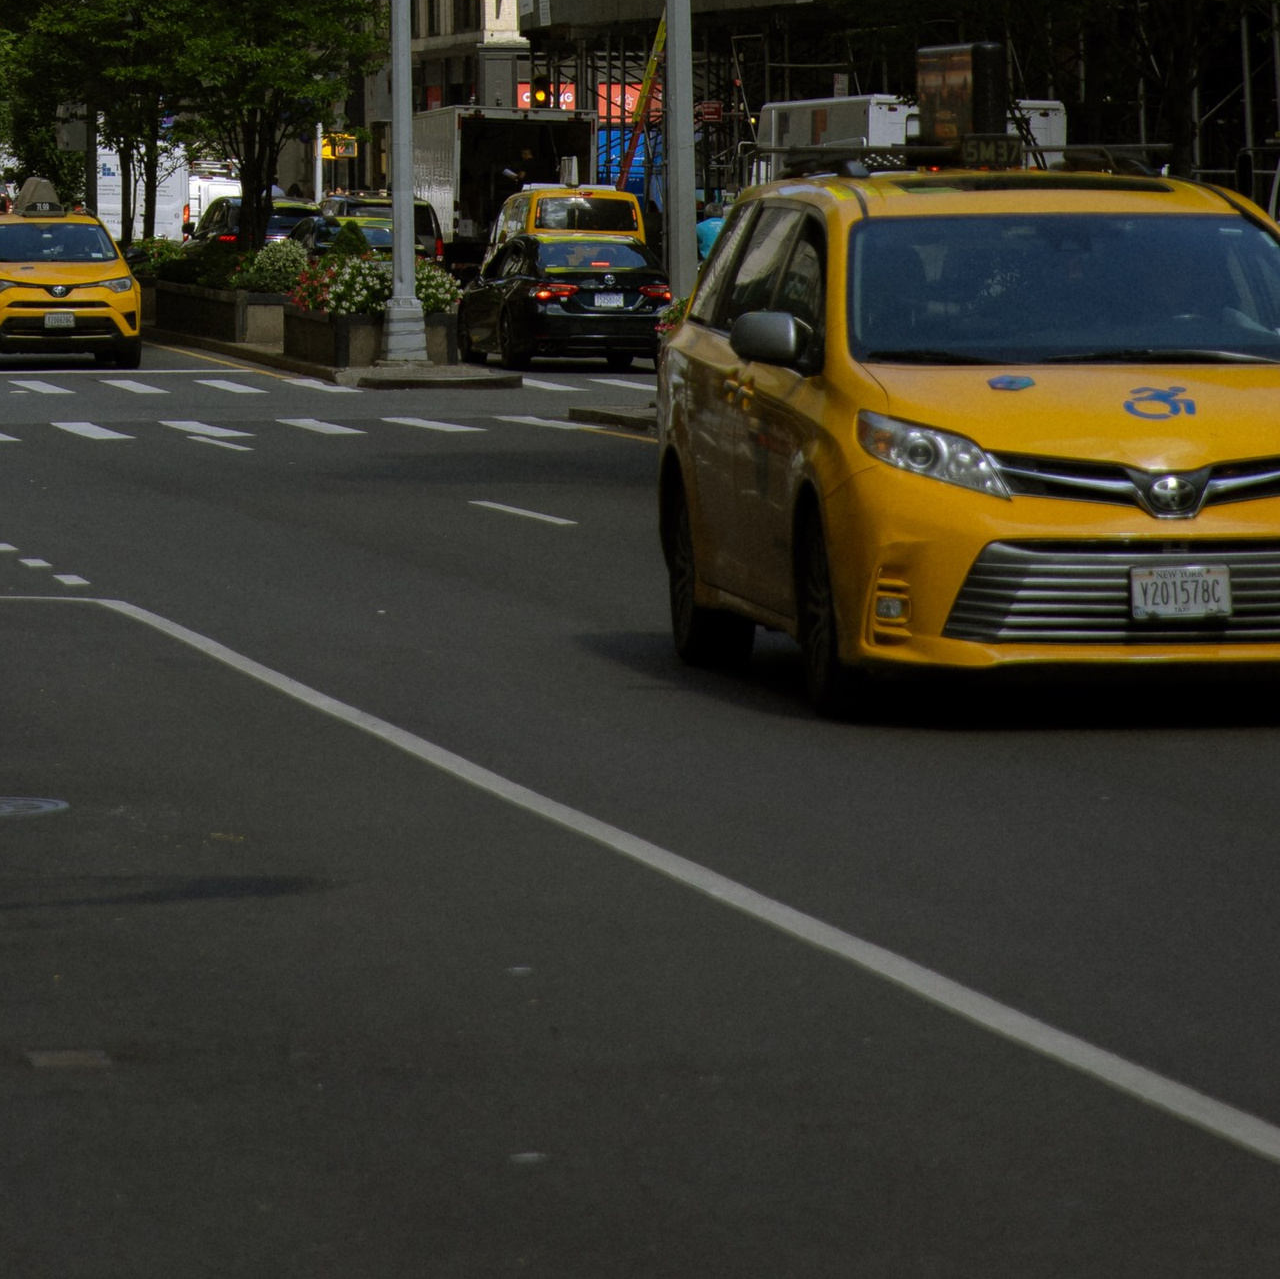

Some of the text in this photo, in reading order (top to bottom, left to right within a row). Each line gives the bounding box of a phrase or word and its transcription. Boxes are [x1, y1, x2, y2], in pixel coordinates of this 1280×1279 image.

[1156, 570, 1203, 579] NEW YORK
[1140, 580, 1220, 607] Y201578C
